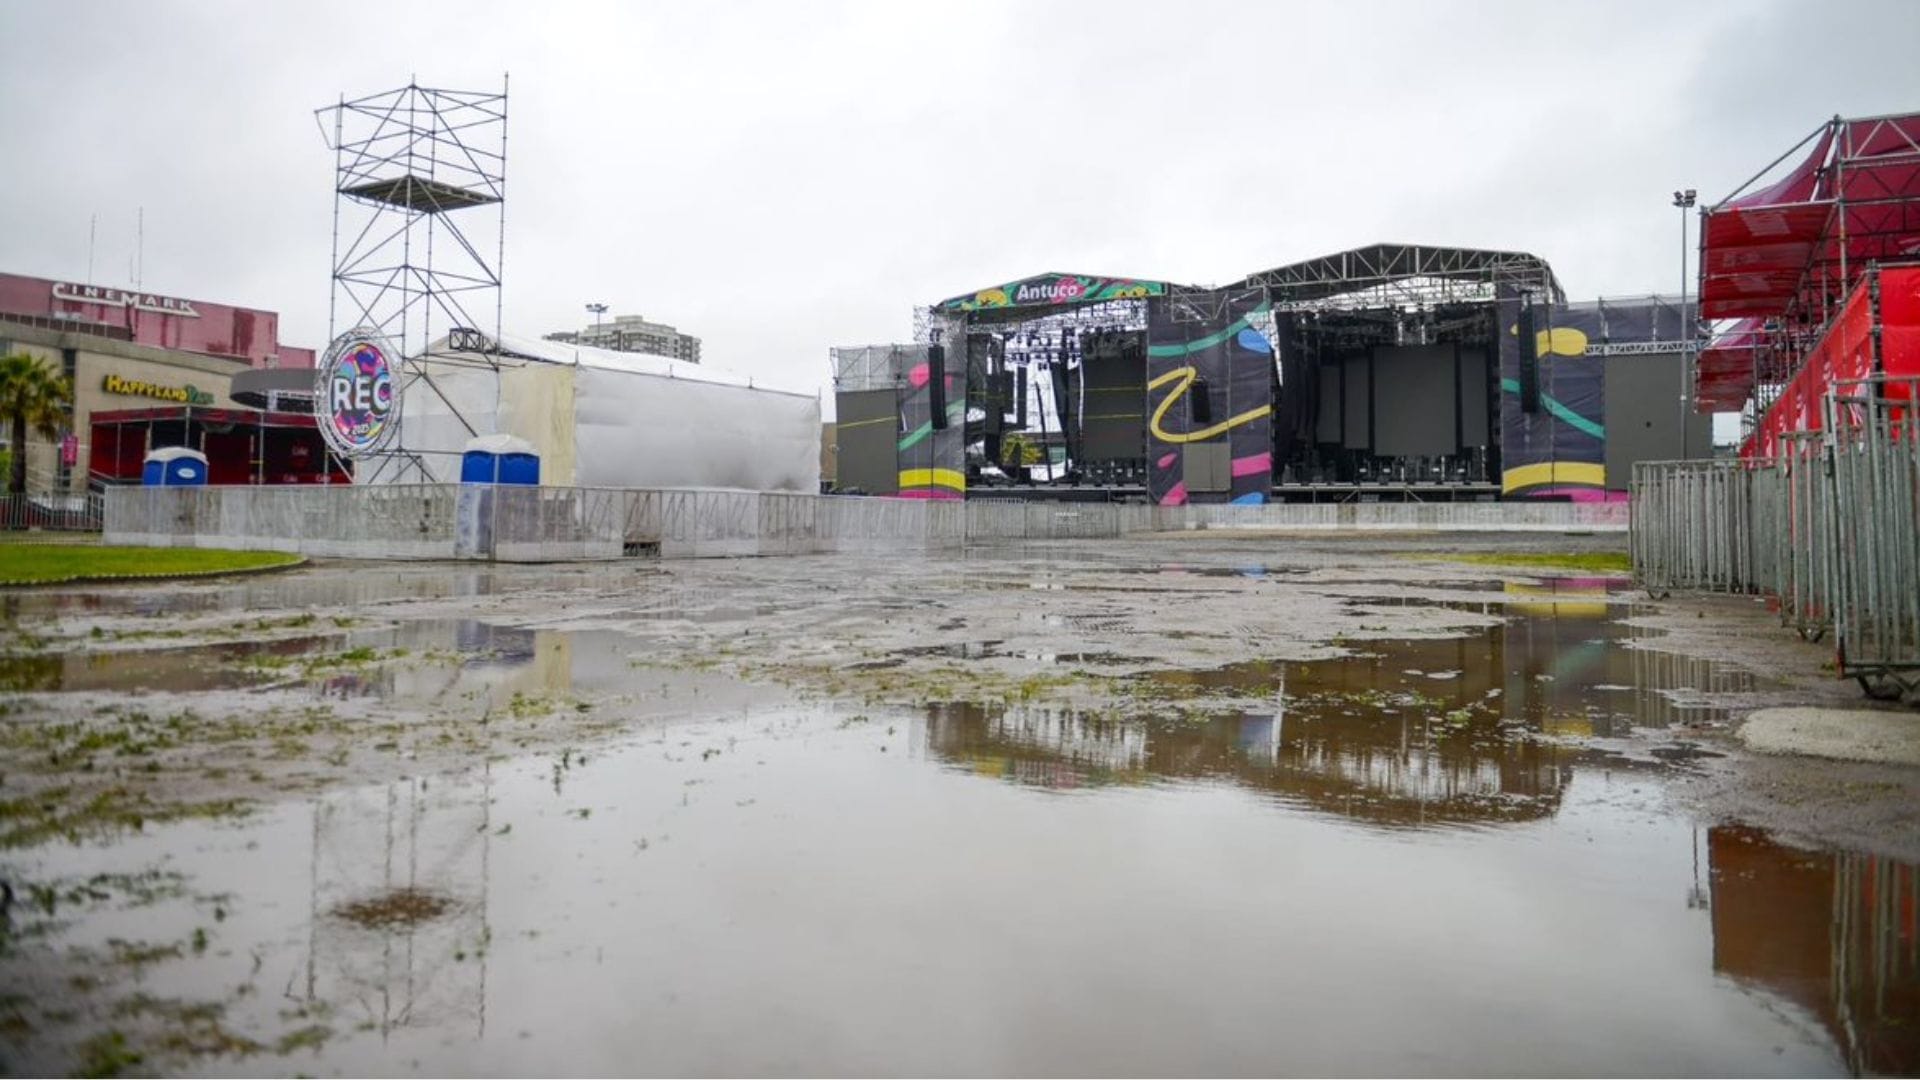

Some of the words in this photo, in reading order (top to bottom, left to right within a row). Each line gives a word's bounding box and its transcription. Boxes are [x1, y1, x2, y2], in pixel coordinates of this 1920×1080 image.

[52, 283, 200, 318] CINEMARK
[1017, 284, 1078, 300] Antuco
[334, 374, 391, 411] REC
